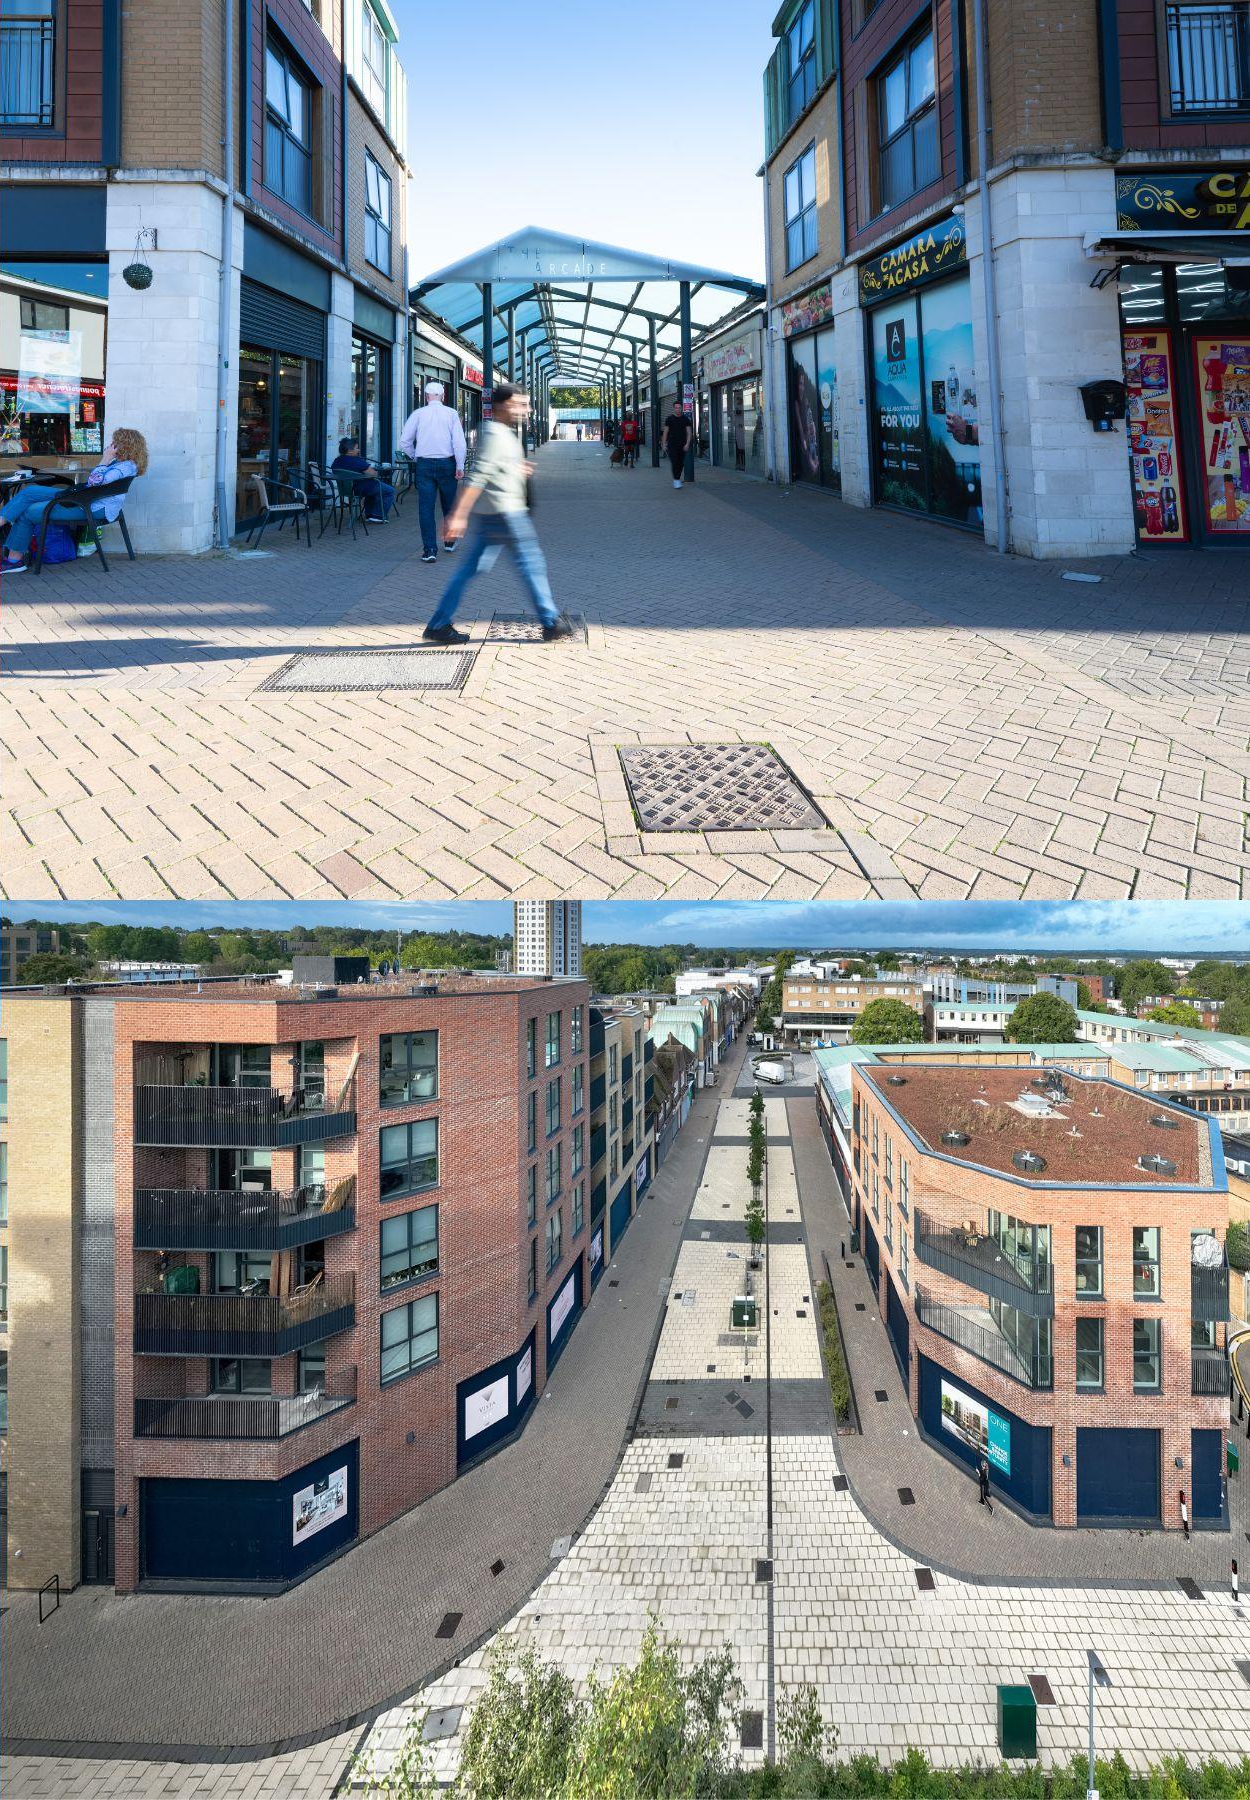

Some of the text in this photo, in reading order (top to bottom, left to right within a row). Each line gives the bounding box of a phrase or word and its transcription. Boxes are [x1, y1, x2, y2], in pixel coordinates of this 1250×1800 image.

[1216, 204, 1237, 214] DE
[535, 262, 607, 275] ARCADE
[881, 414, 920, 427] FOR YOU
[990, 1415, 1008, 1433] ONE
